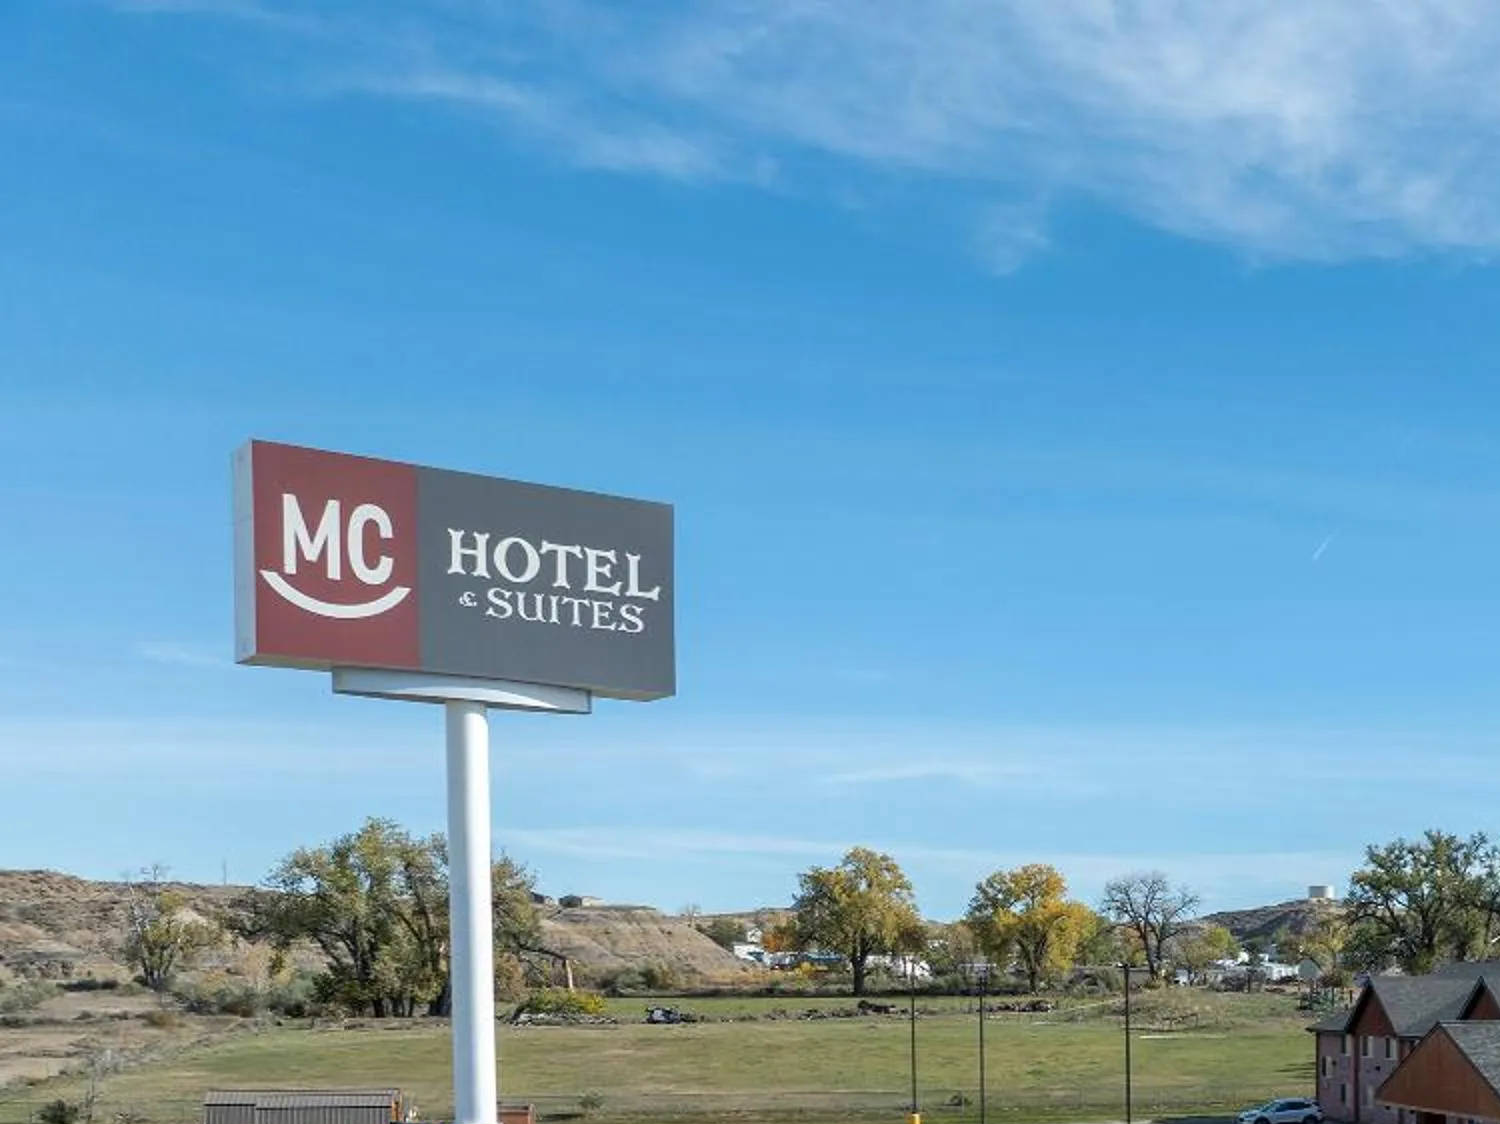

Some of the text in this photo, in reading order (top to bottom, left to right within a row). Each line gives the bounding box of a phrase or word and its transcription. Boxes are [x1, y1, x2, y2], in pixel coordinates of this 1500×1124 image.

[282, 493, 393, 585] MC
[447, 528, 660, 601] HOTEL
[459, 587, 645, 634] & SUITES
